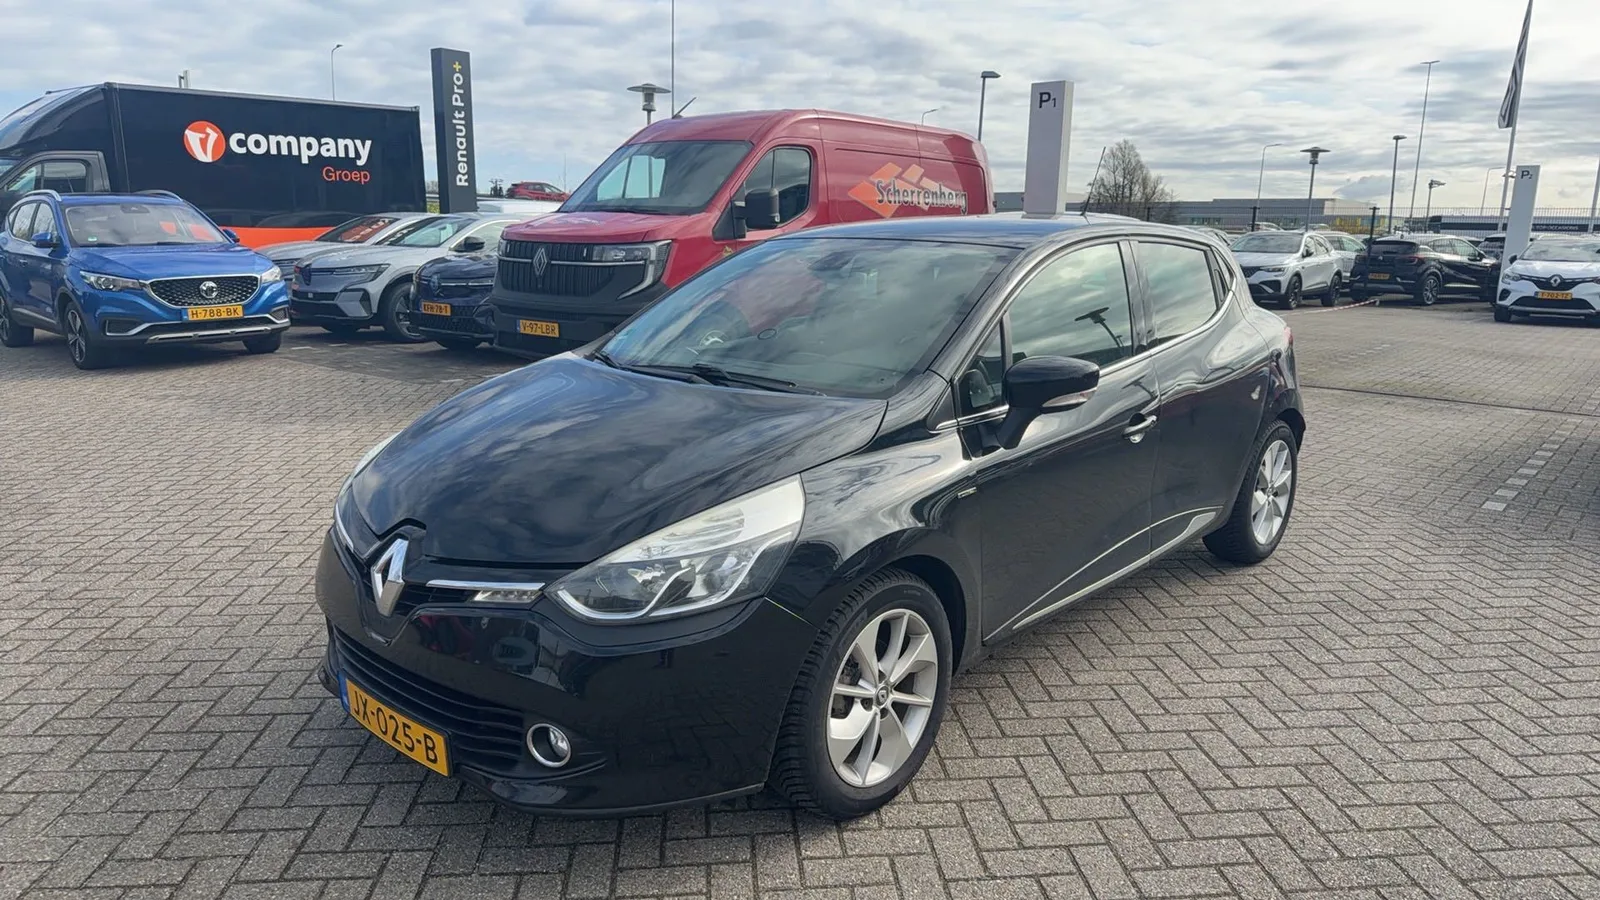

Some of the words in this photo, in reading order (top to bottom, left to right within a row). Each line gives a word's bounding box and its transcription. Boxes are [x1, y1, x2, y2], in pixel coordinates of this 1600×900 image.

[452, 61, 465, 107] Pro+
[229, 132, 372, 166] company
[452, 110, 469, 186] Renault
[322, 166, 370, 185] Groep
[876, 179, 968, 215] Scherrenberg
[190, 307, 240, 319] H-788-BK
[521, 322, 556, 335] V-97-LBR
[353, 690, 438, 765] JX-025-B
